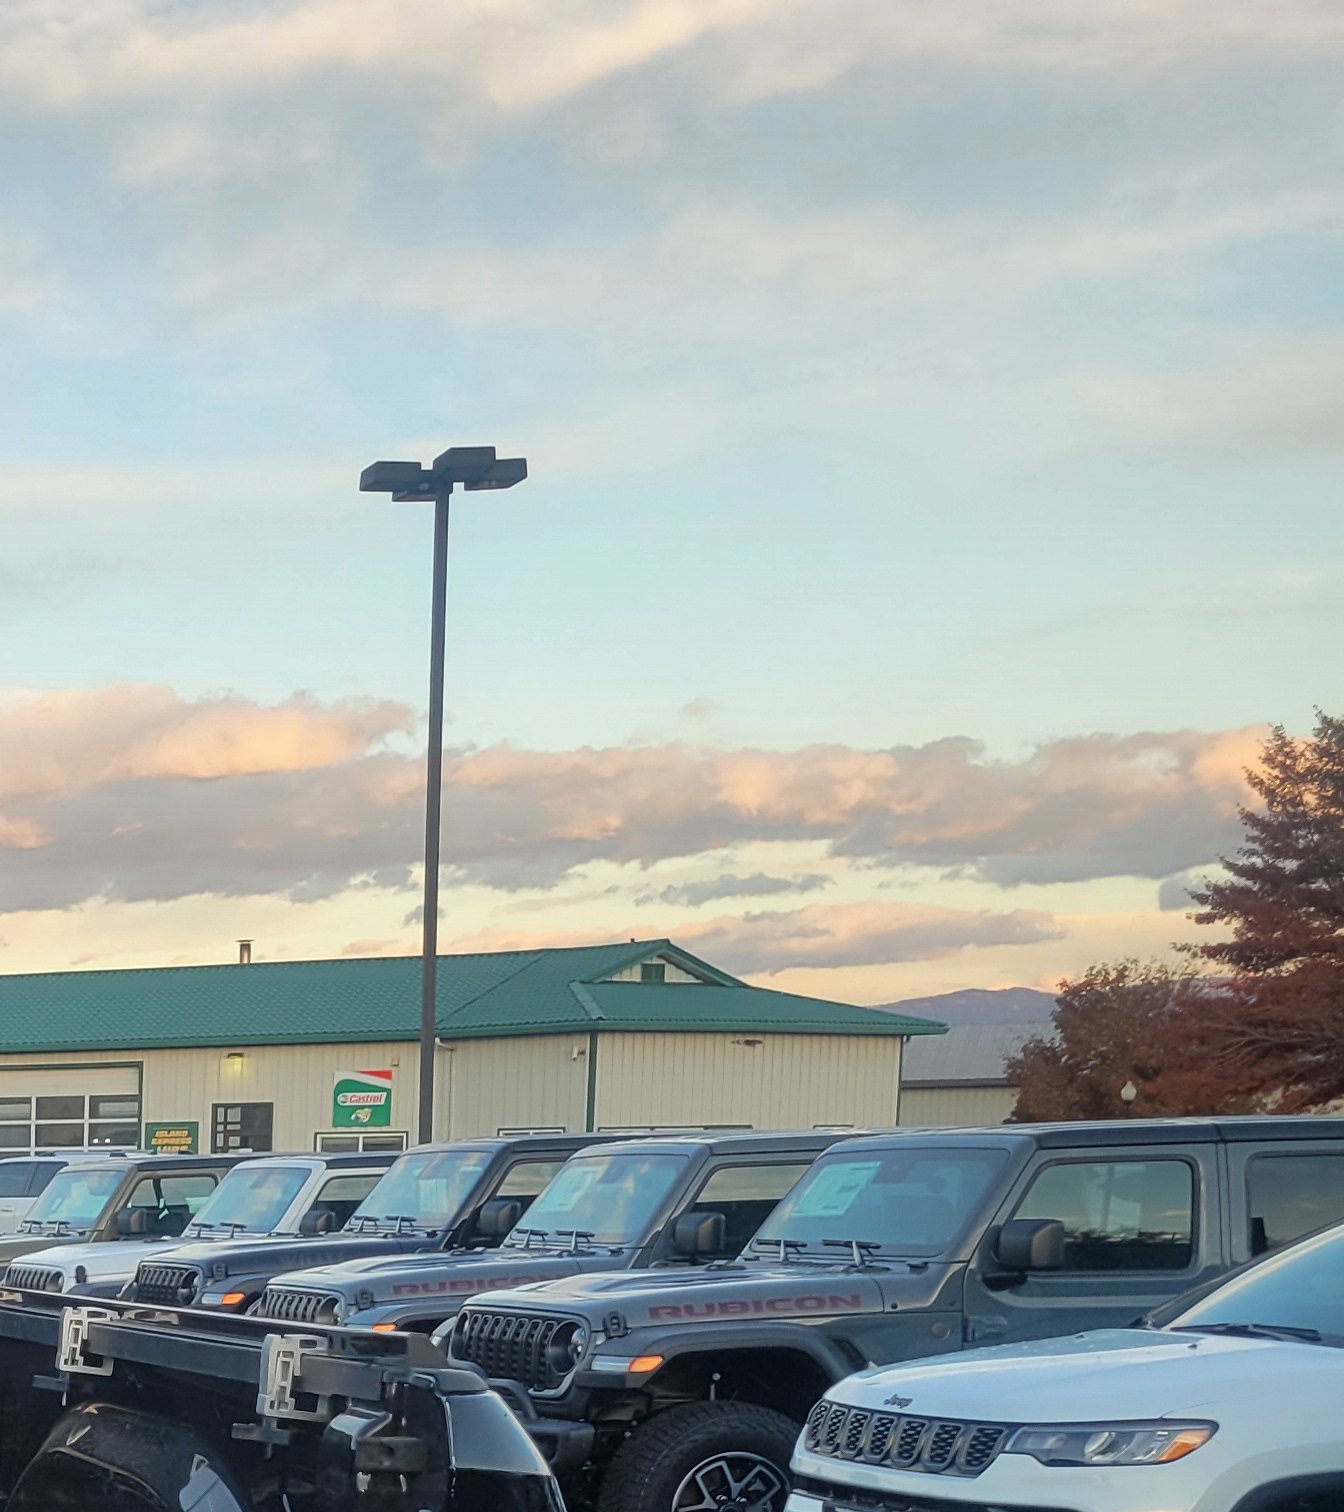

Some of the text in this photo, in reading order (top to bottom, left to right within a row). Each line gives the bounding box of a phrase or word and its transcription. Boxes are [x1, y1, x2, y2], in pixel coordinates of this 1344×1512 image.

[349, 1094, 383, 1104] Castrol
[151, 1137, 192, 1145] EXPRESS
[647, 1294, 862, 1320] RUBICON
